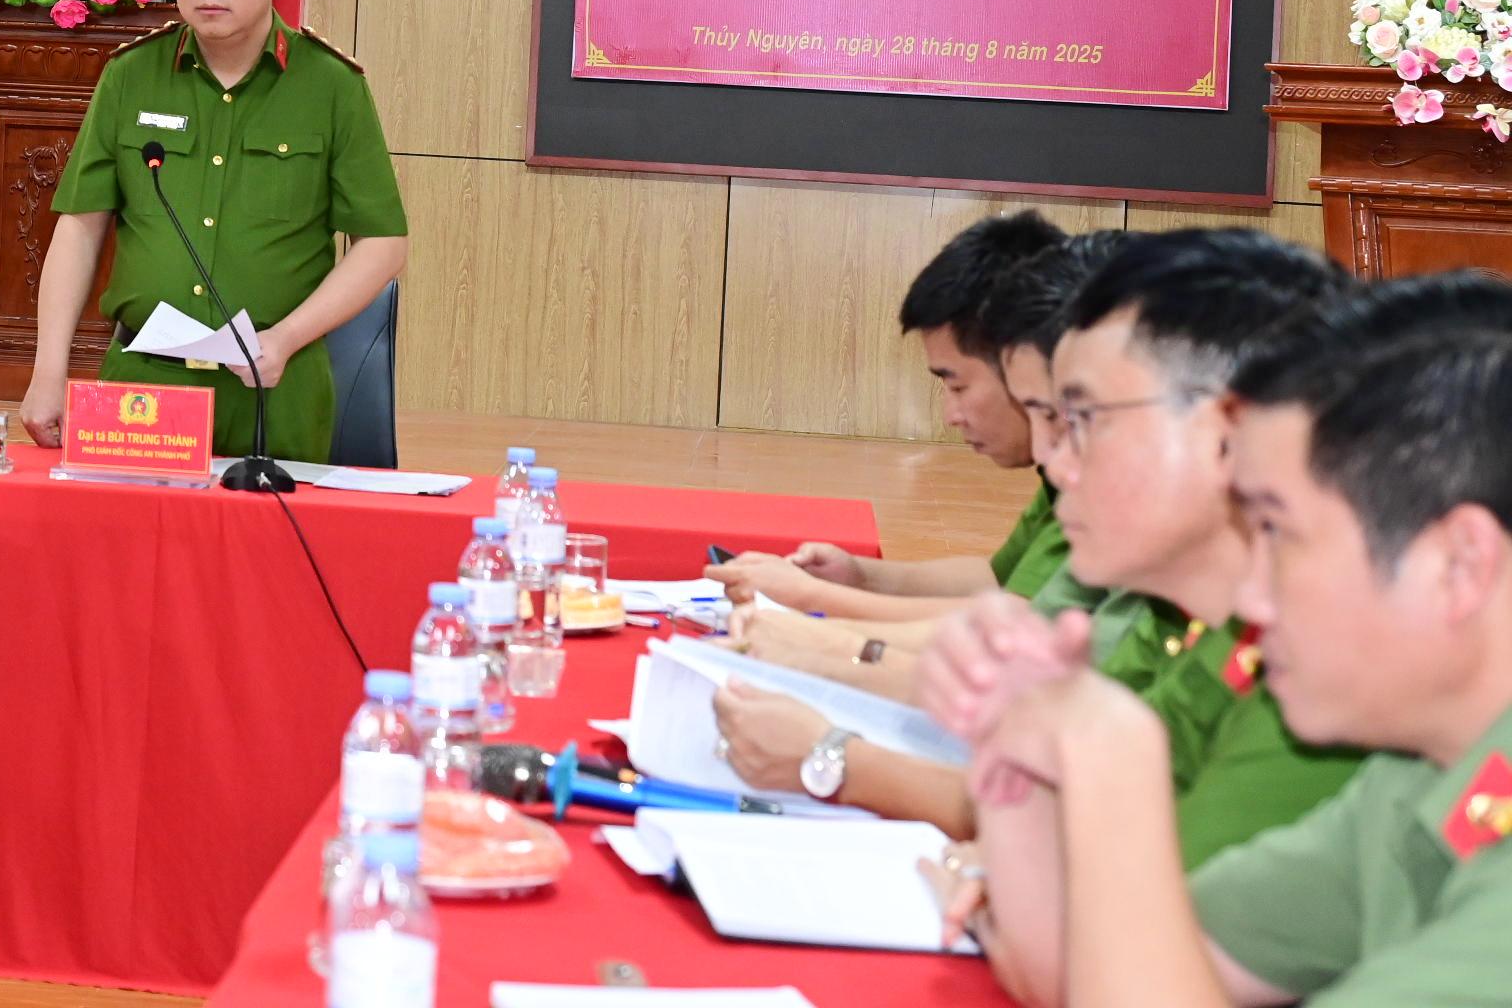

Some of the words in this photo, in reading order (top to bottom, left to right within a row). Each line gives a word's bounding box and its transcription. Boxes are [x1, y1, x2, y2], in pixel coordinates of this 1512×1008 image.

[692, 25, 740, 51] Thủy
[746, 28, 826, 53] Nguyên,
[836, 35, 885, 57] ngày
[890, 36, 914, 55] 28
[921, 36, 979, 62] tháng
[985, 40, 998, 59] 8
[1003, 42, 1047, 61] năm
[1054, 43, 1103, 64] 2025
[127, 432, 160, 446] TRUNG
